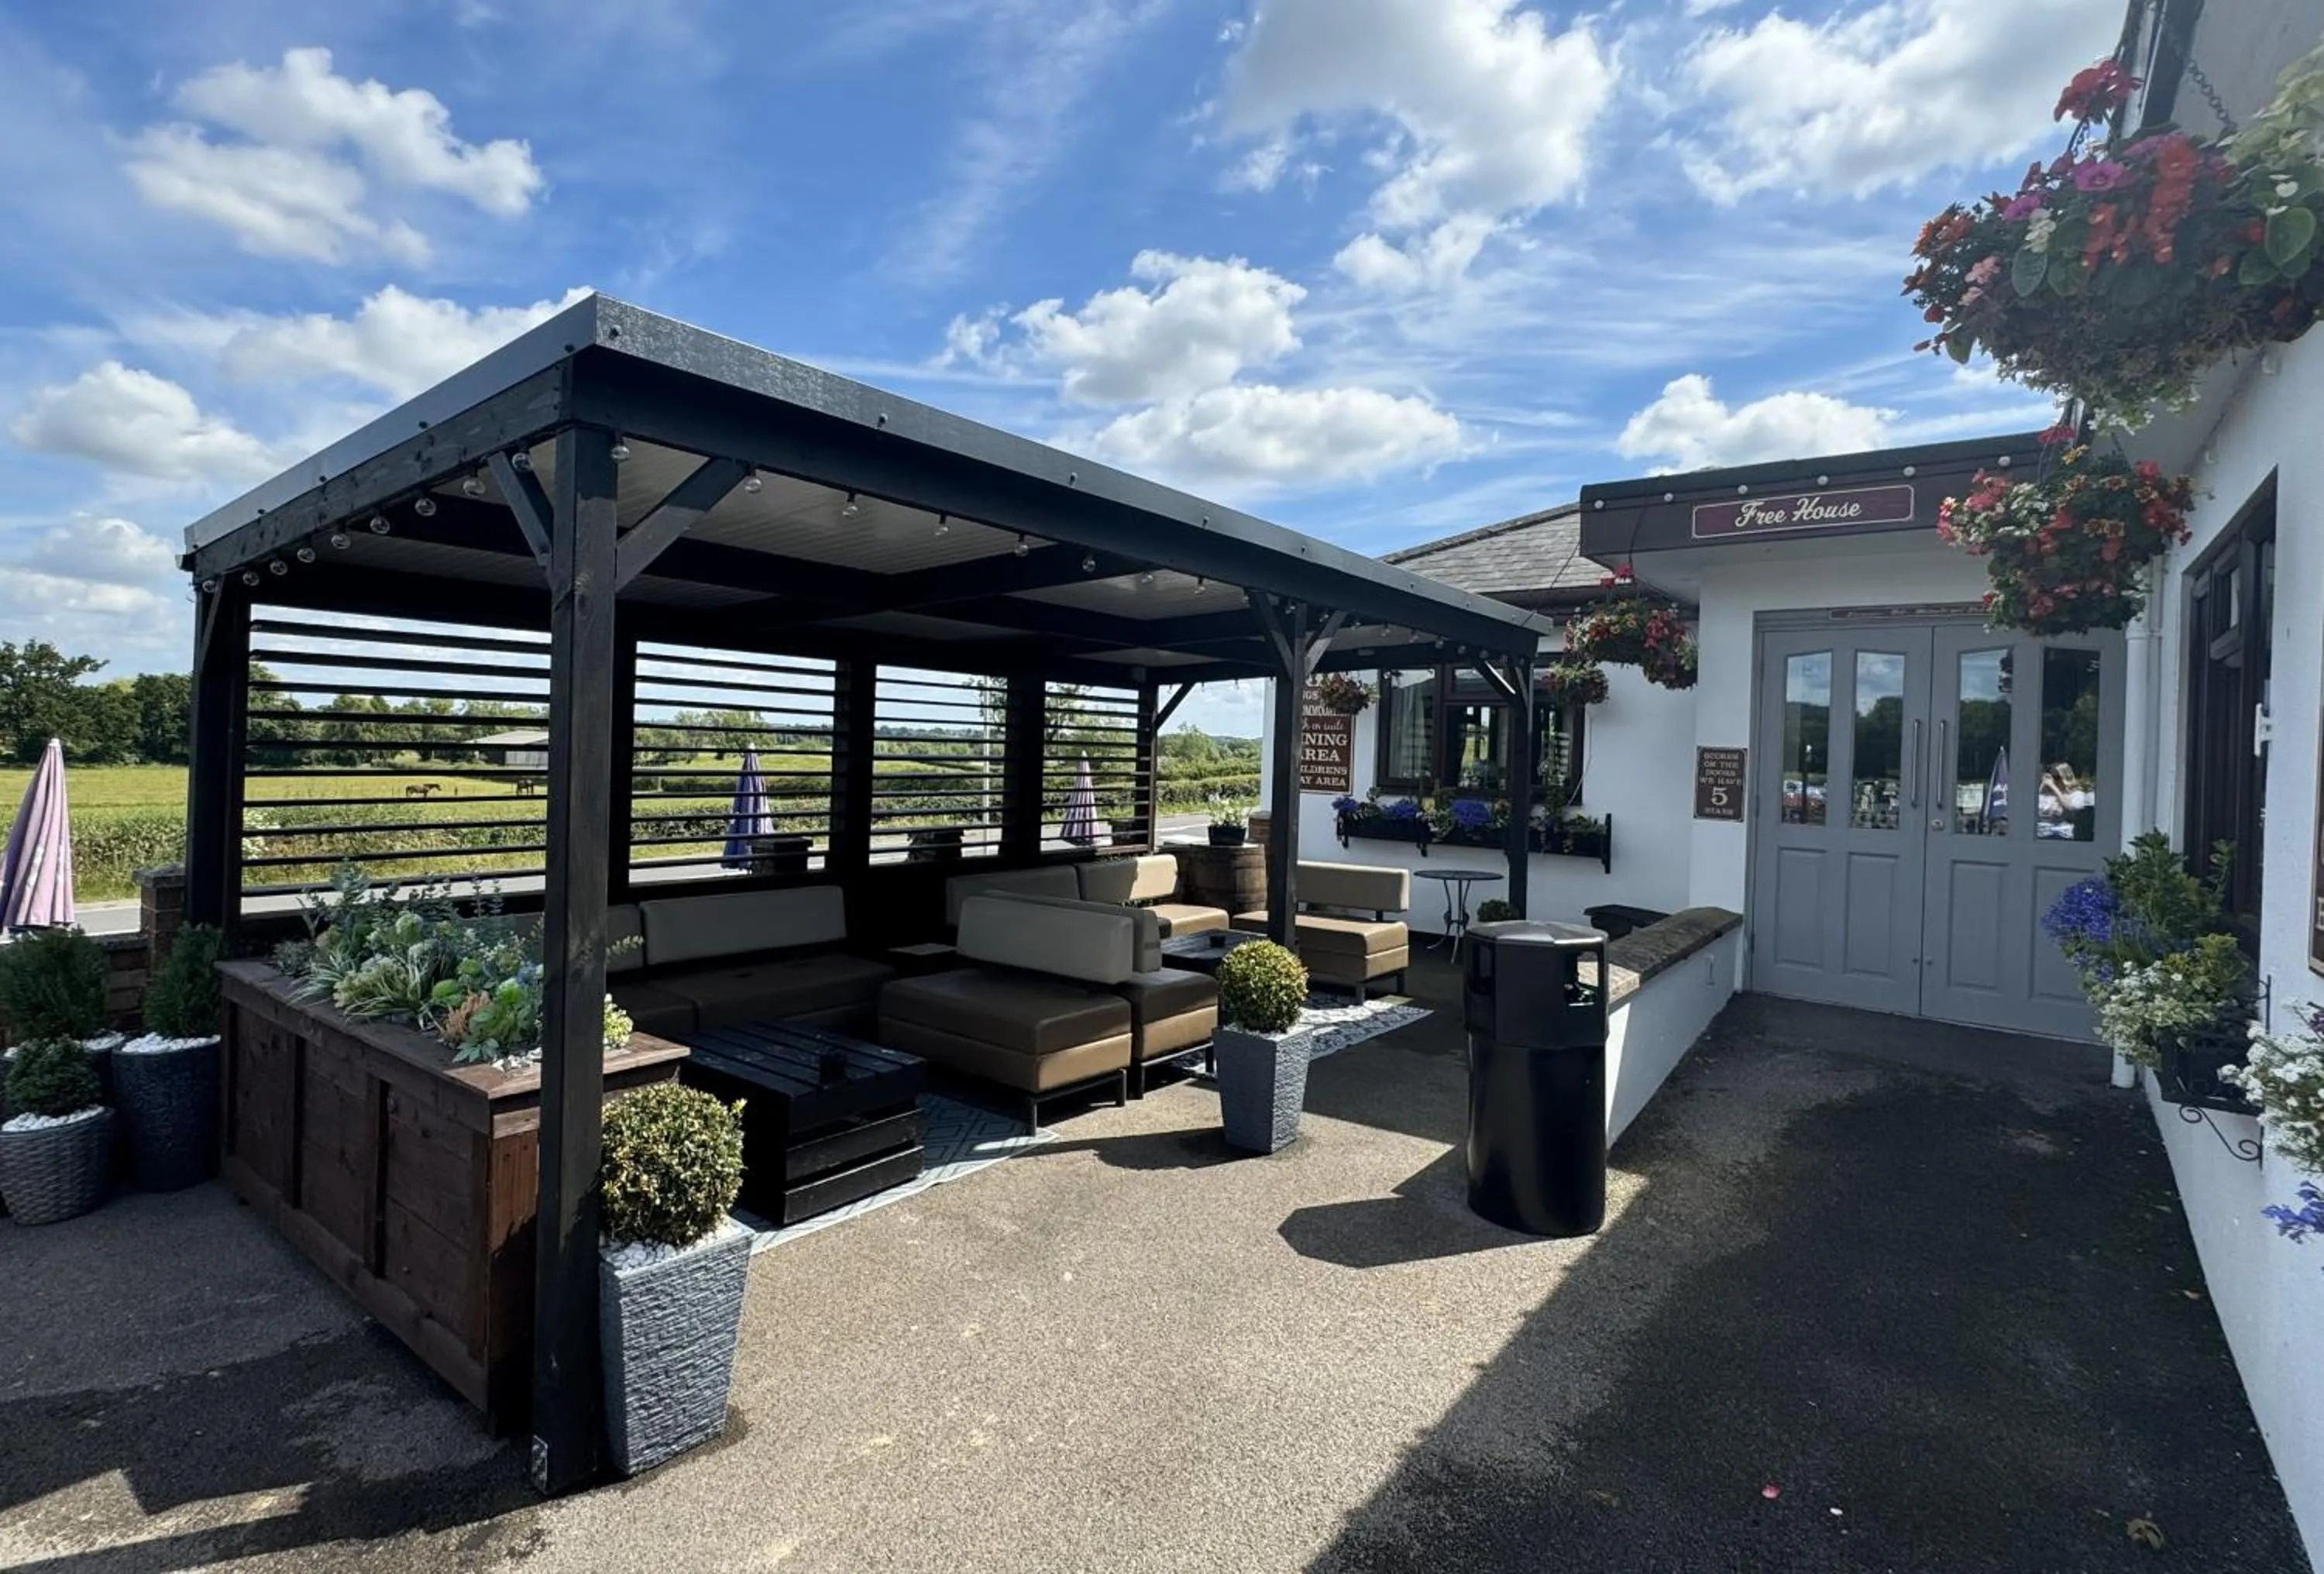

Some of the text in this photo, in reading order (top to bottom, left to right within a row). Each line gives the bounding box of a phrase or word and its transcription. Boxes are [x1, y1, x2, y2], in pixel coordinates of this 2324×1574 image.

[1734, 497, 1862, 528] Free House
[1301, 733, 1348, 747] INING
[1301, 748, 1340, 762] REA
[1315, 776, 1346, 787] AREA
[1710, 786, 1728, 806] 5
